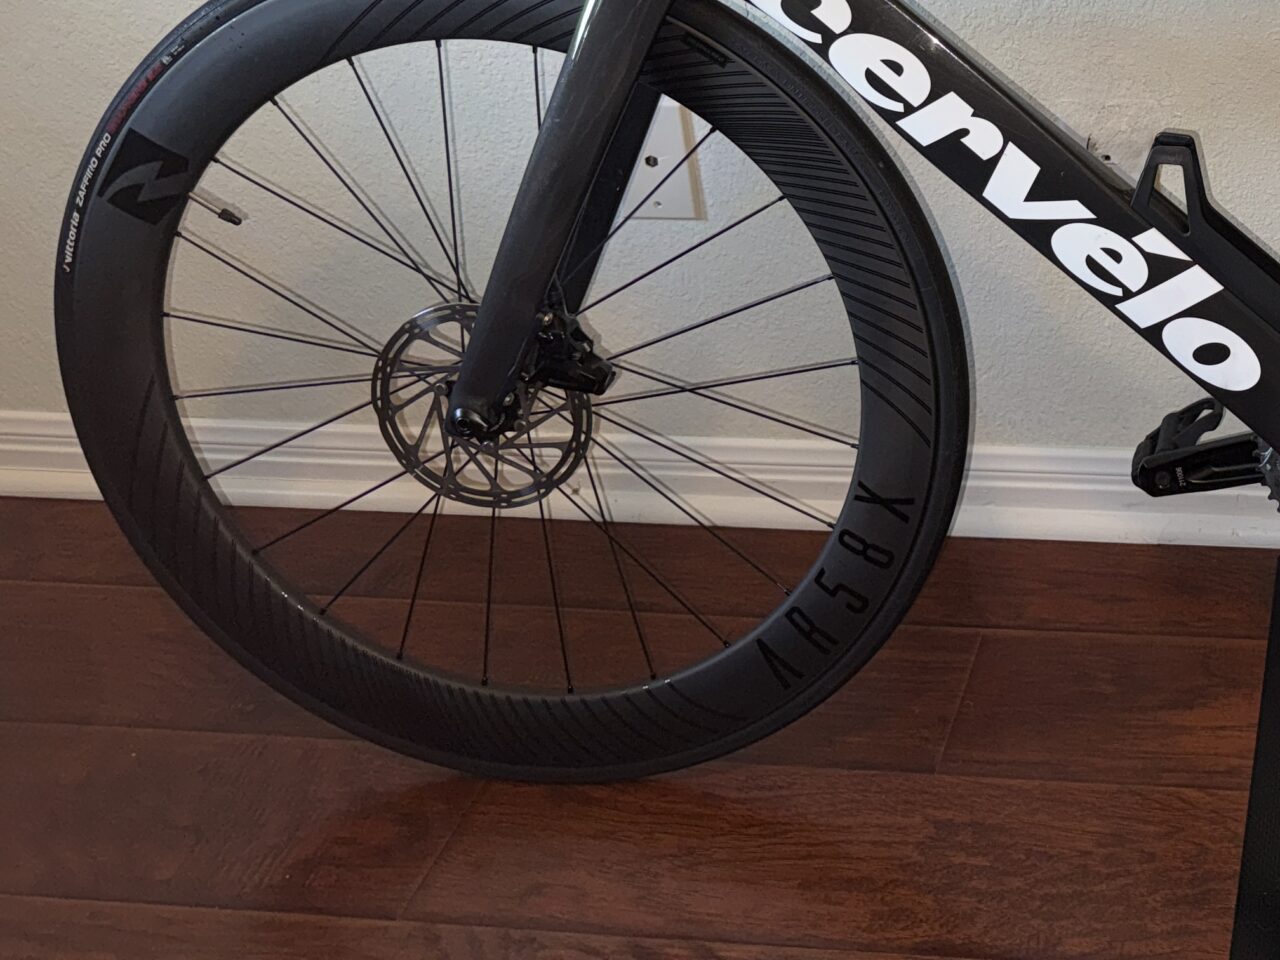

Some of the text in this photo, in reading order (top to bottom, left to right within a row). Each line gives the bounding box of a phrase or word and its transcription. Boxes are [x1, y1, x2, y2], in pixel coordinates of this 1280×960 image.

[64, 132, 112, 264] vittoria ZAFFIRO PRO
[756, 480, 916, 691] AR58X
